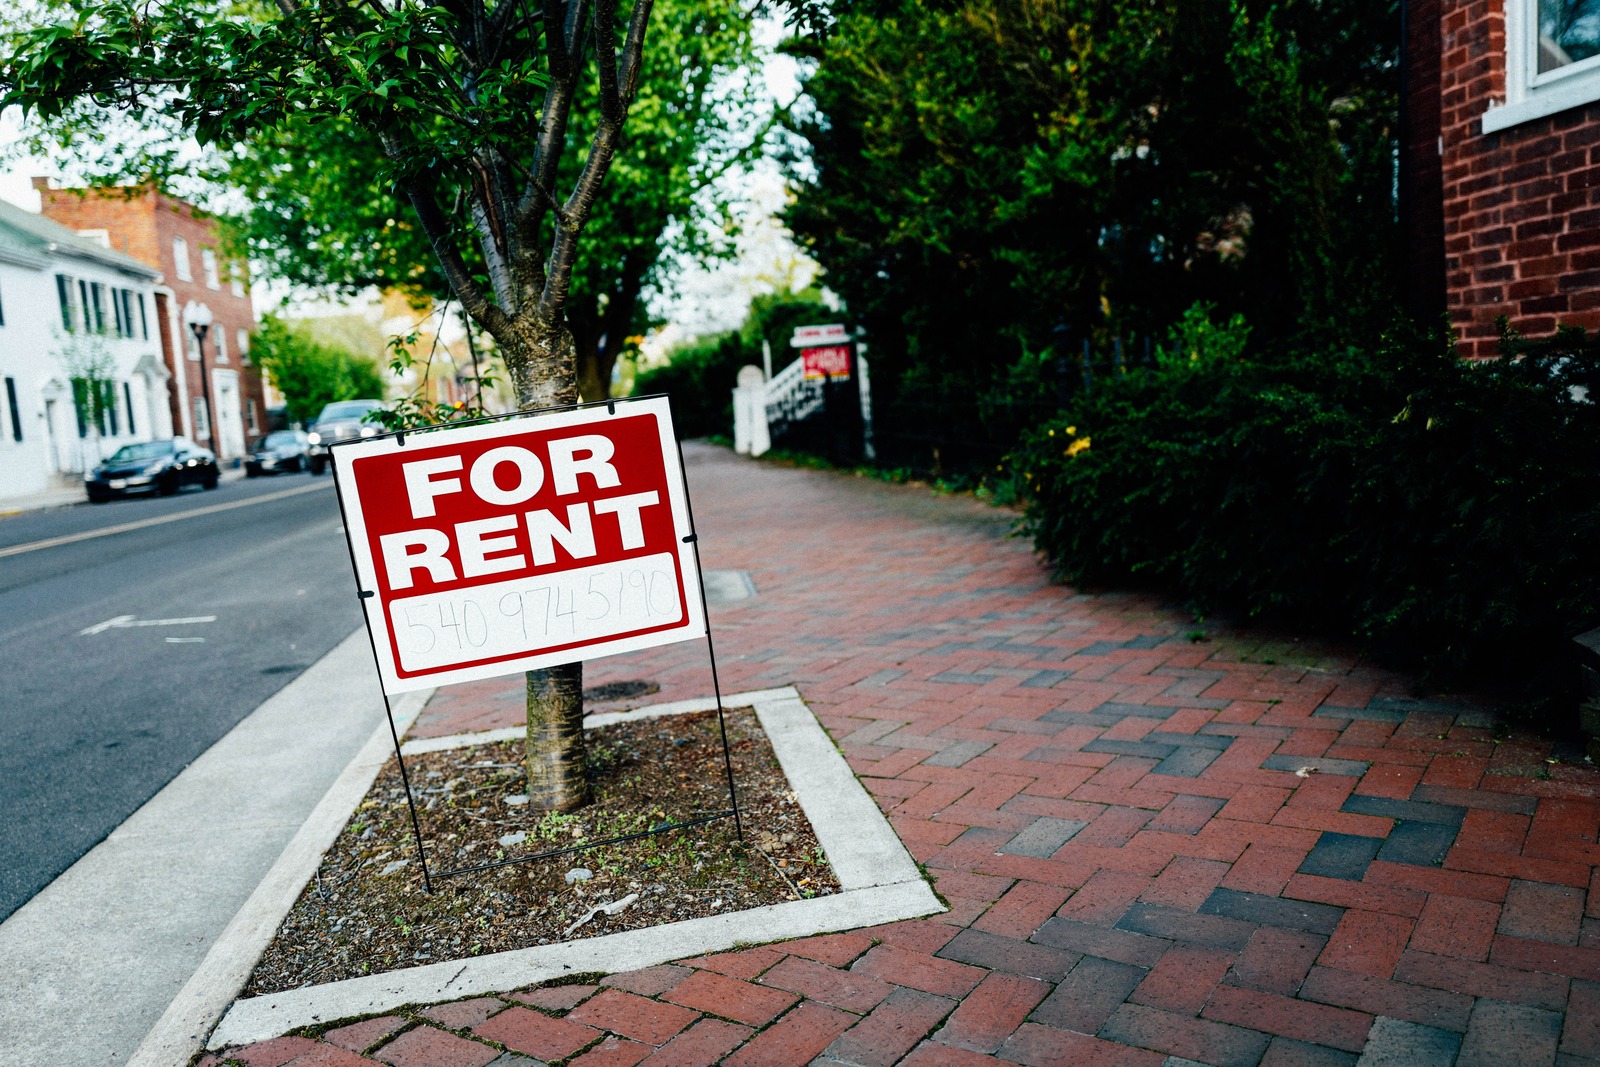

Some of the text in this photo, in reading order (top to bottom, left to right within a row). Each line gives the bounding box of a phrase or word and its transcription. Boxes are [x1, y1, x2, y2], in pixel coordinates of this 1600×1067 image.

[402, 435, 621, 519] FOR
[380, 490, 660, 590] RENT
[403, 599, 488, 654] 540
